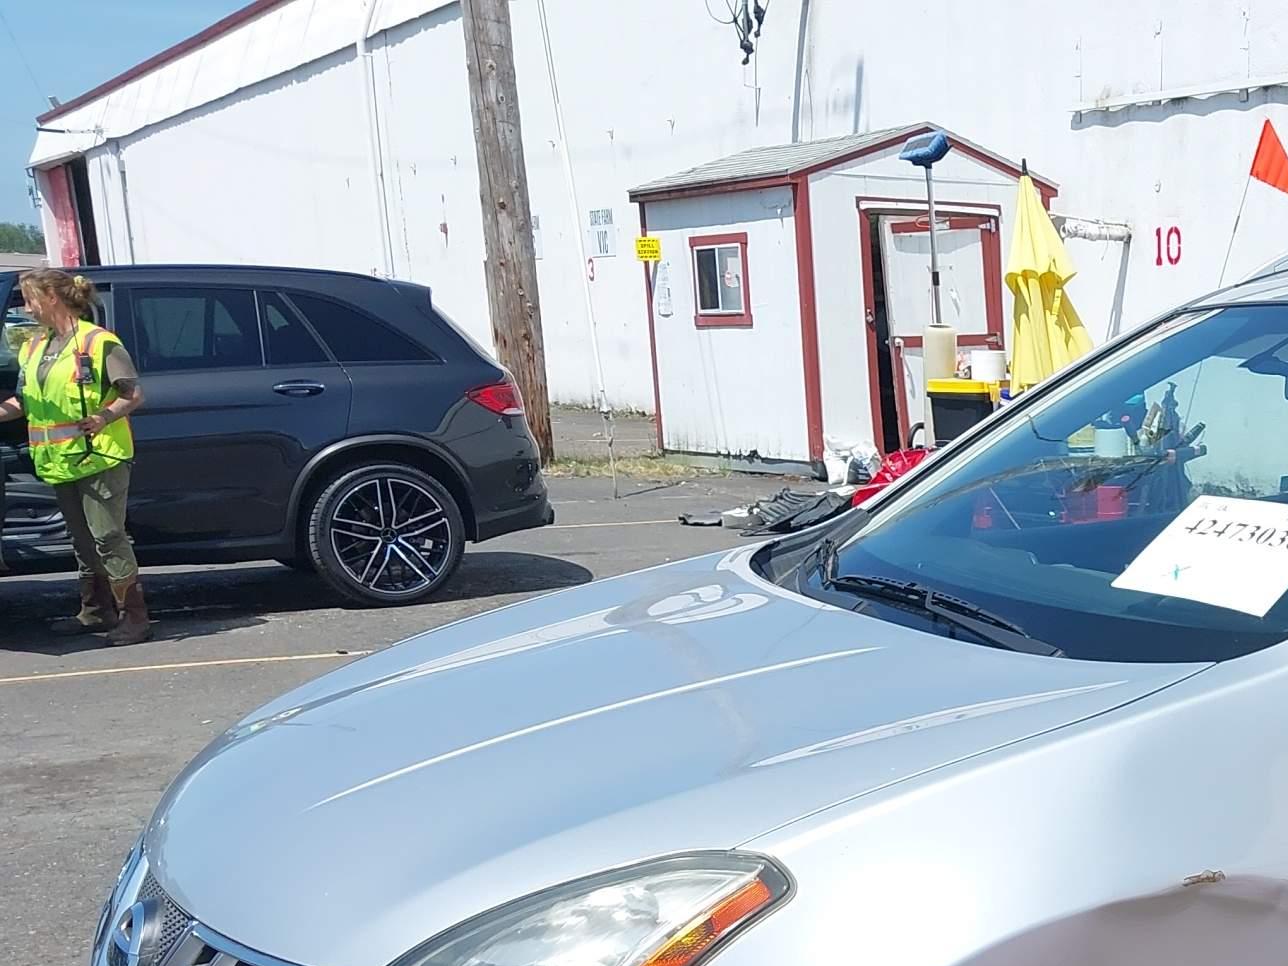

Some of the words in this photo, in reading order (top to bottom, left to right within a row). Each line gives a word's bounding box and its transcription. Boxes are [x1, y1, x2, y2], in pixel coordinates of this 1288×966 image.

[596, 230, 609, 254] VIC
[1155, 226, 1182, 266] 10
[587, 257, 595, 282] 3
